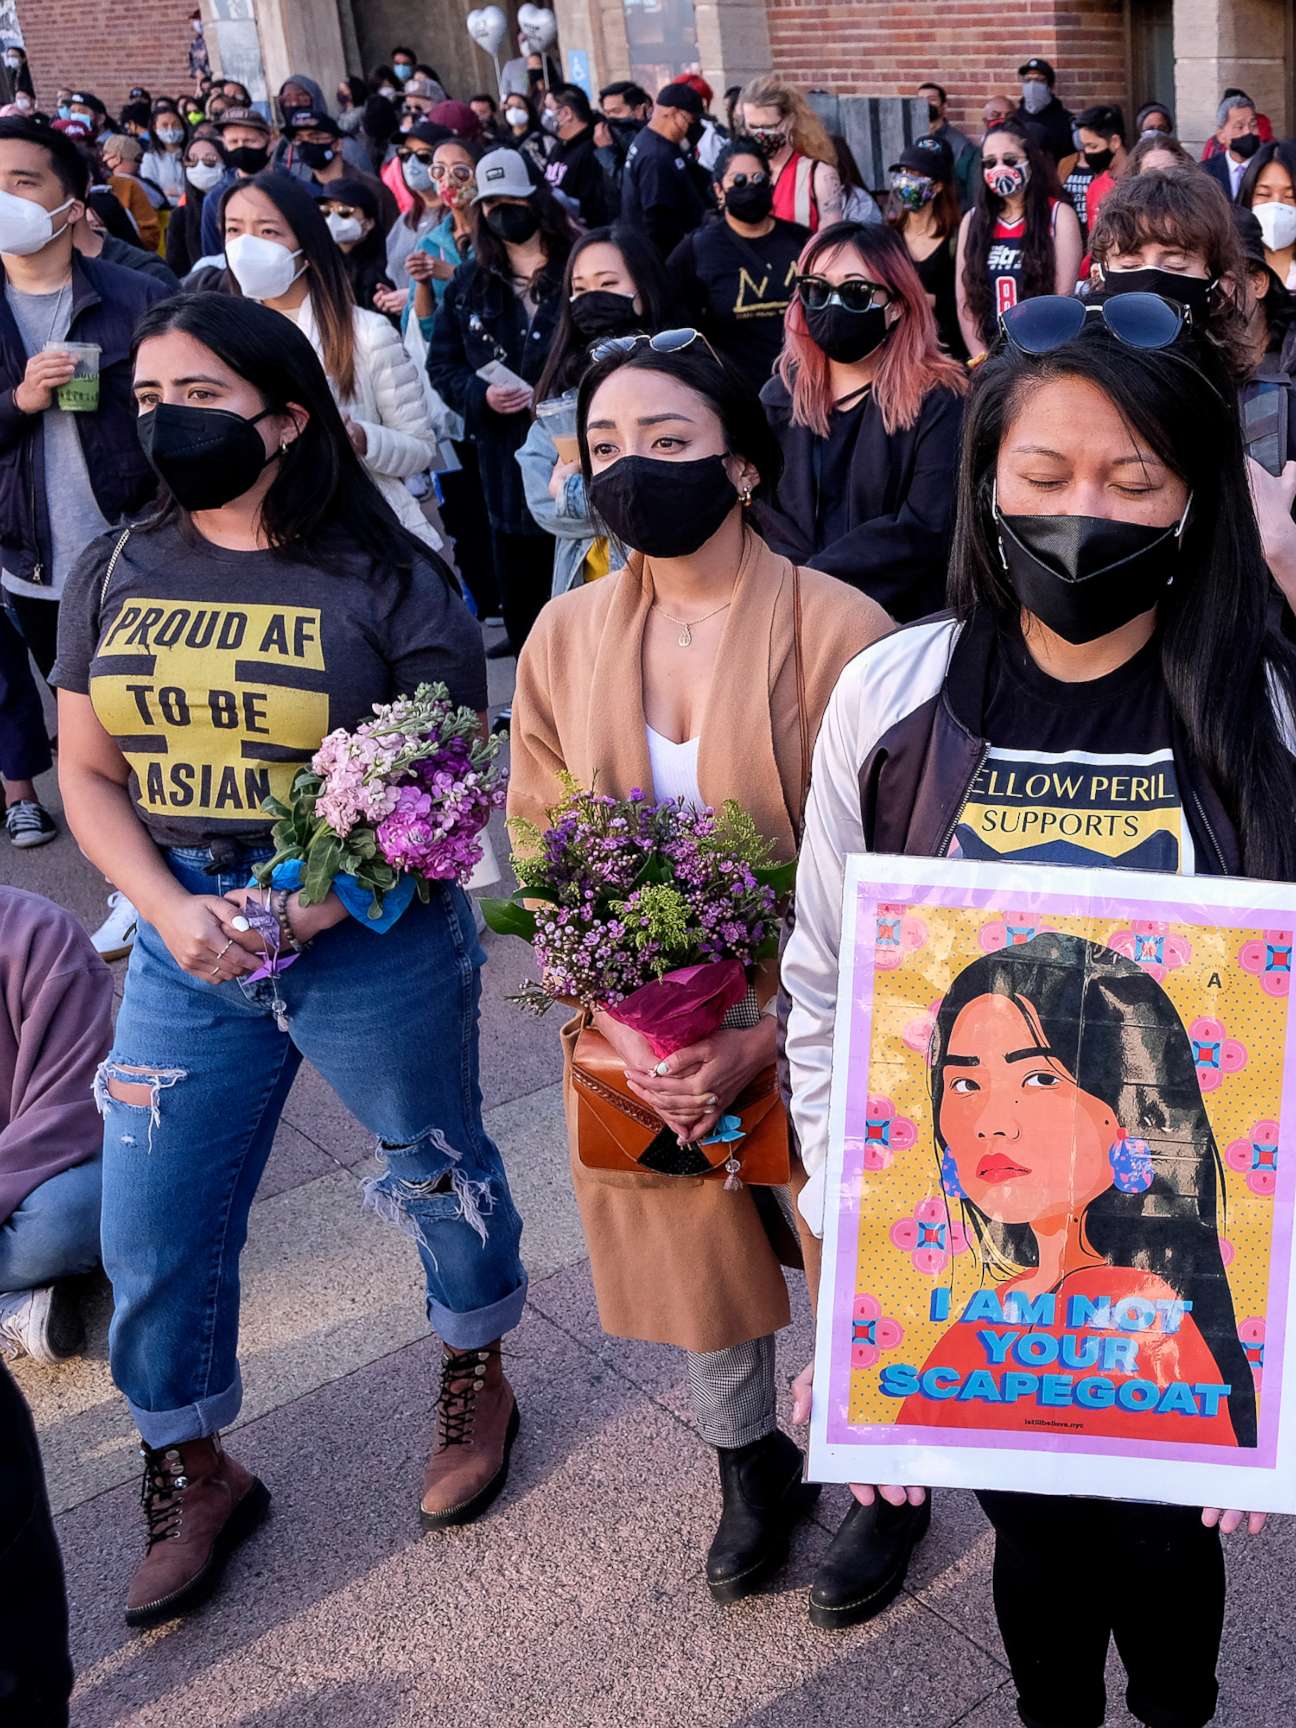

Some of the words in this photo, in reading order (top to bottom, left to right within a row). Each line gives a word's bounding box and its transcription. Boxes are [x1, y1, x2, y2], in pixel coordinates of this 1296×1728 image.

[106, 606, 248, 650] PROUD
[258, 614, 316, 658] AF
[126, 684, 192, 727] TO
[208, 689, 270, 735] BE
[146, 762, 270, 810] ASIAN
[1090, 773, 1175, 801] PERIL
[981, 809, 1140, 837] SUPPORTS
[929, 1287, 952, 1322] I
[960, 1289, 1057, 1327] AM
[1066, 1294, 1194, 1334] NOT
[977, 1329, 1140, 1373] YOUR
[879, 1363, 1232, 1419] SCAPEGOAT
